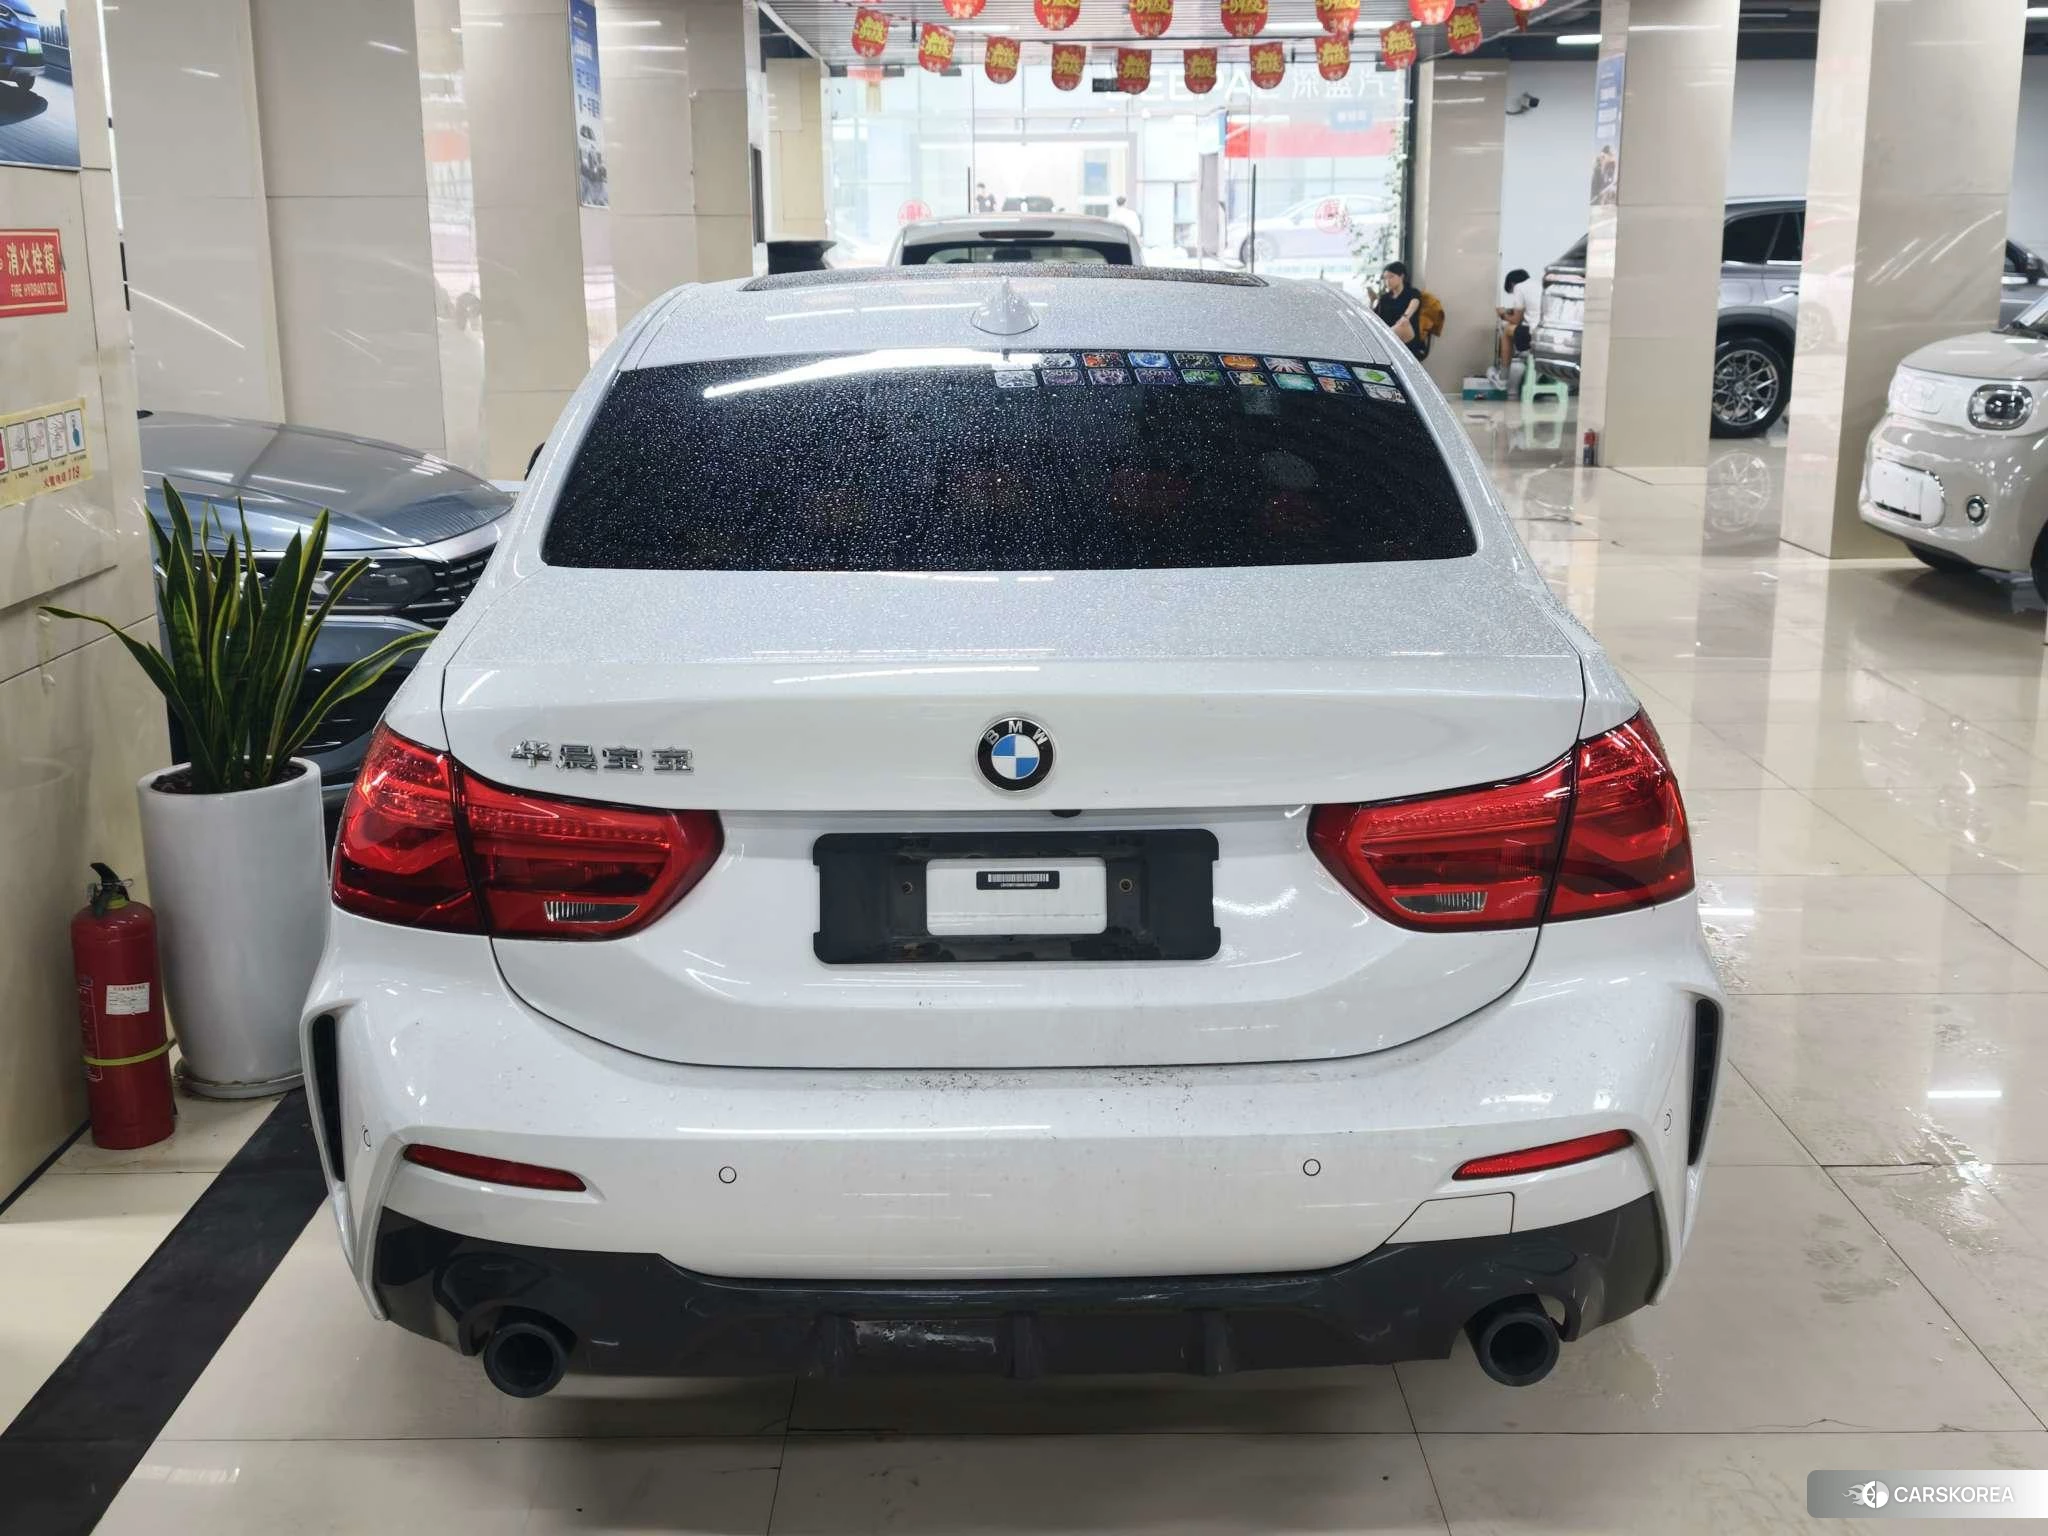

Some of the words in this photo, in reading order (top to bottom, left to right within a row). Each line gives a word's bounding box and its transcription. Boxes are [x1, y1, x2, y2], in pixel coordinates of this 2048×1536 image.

[1105, 69, 1281, 100] EEA
[6, 242, 55, 276] 消火栓箱
[983, 720, 1048, 746] BMW
